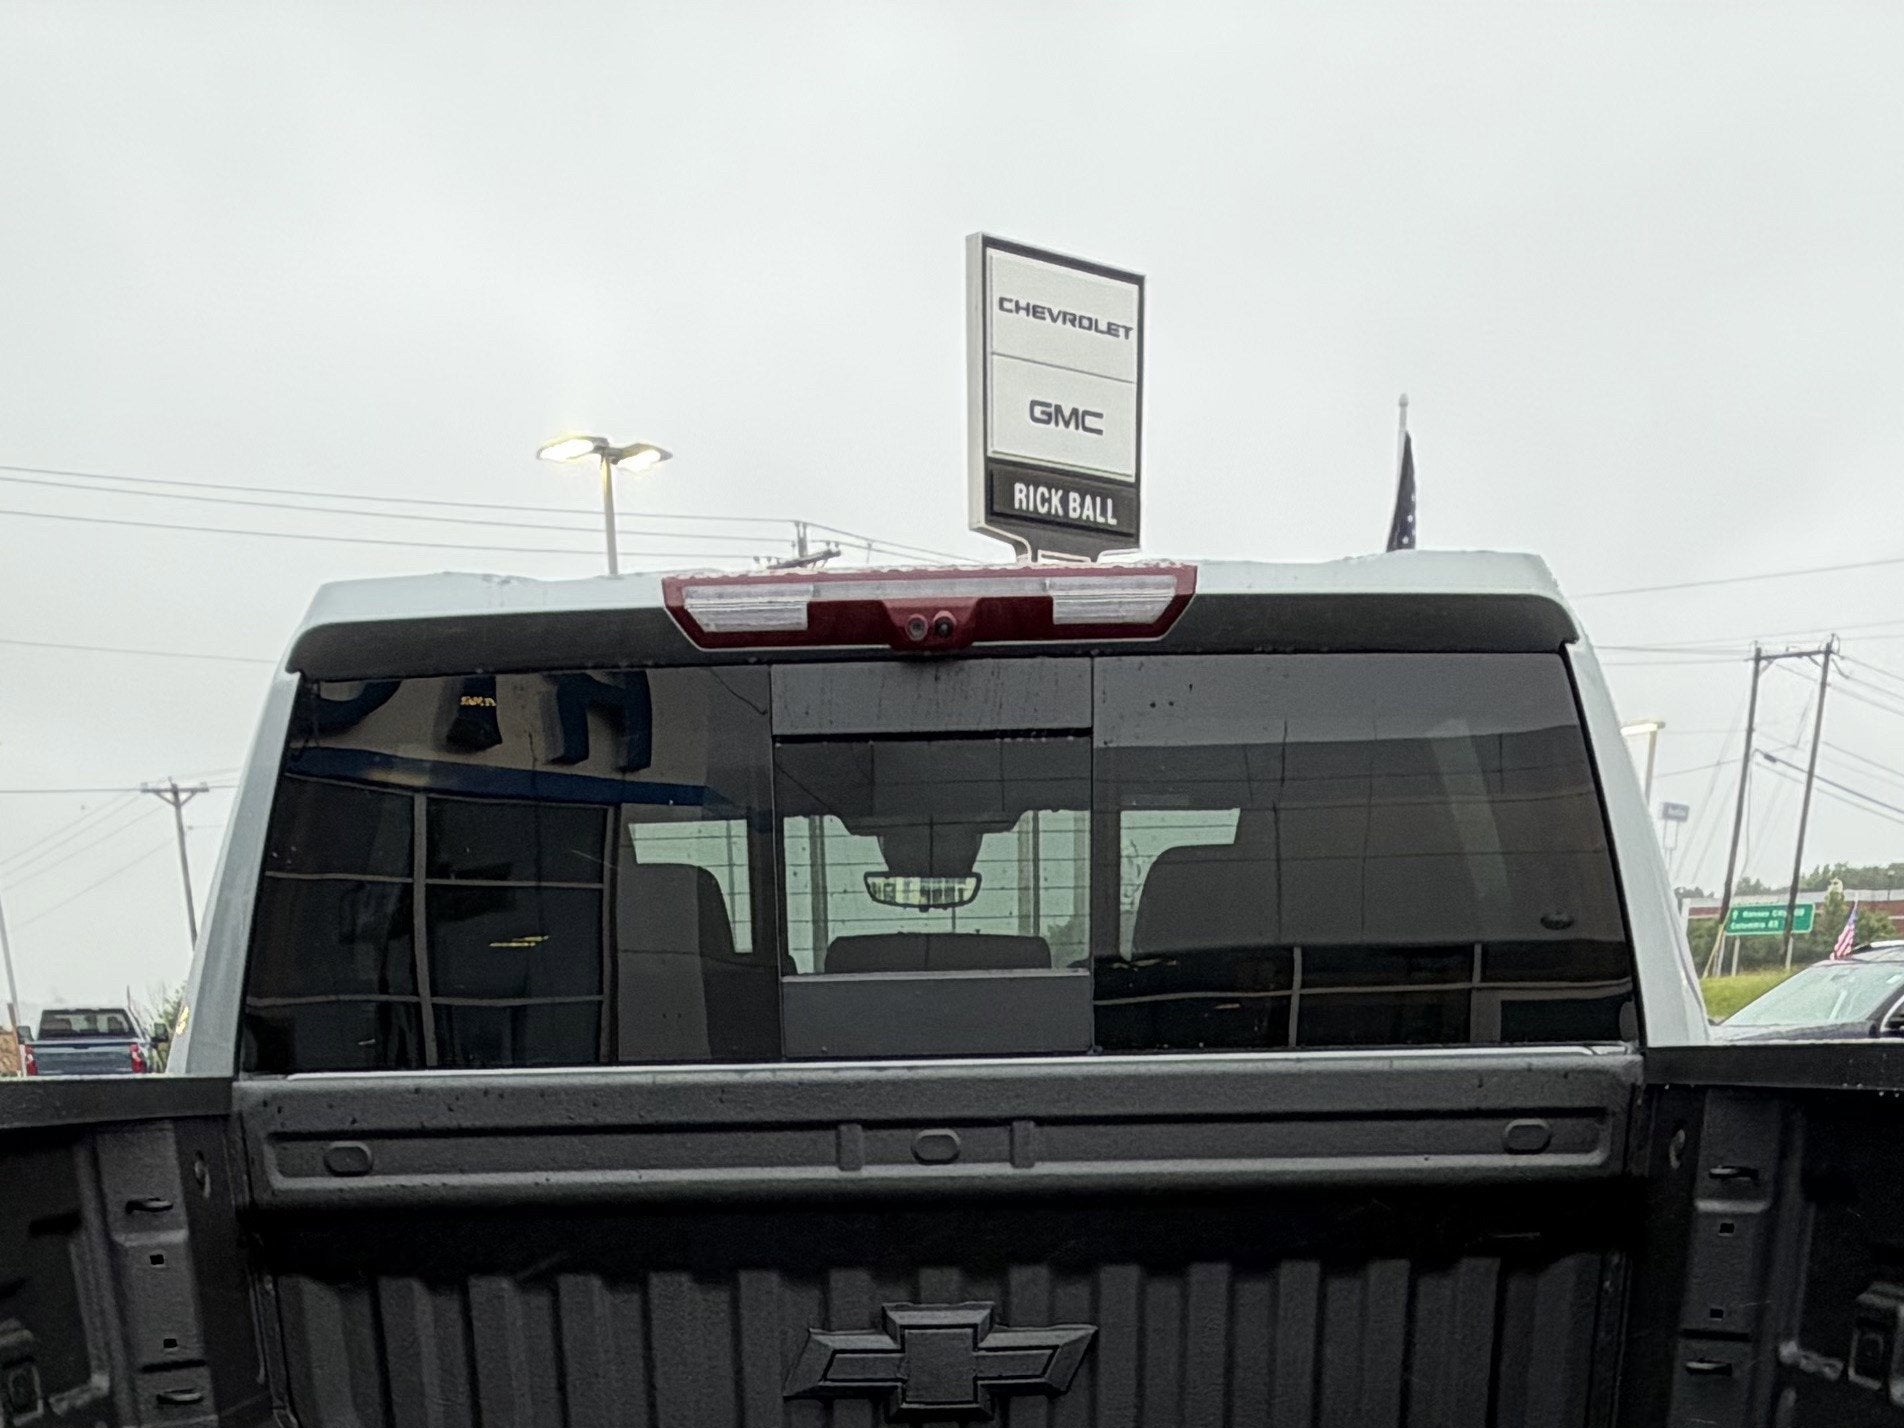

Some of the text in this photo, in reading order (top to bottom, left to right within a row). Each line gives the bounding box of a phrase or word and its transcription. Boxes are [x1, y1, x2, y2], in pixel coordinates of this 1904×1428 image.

[998, 296, 1134, 341] CHEVROLET
[1028, 399, 1105, 436] GMC
[1013, 482, 1118, 527] RICK BALL
